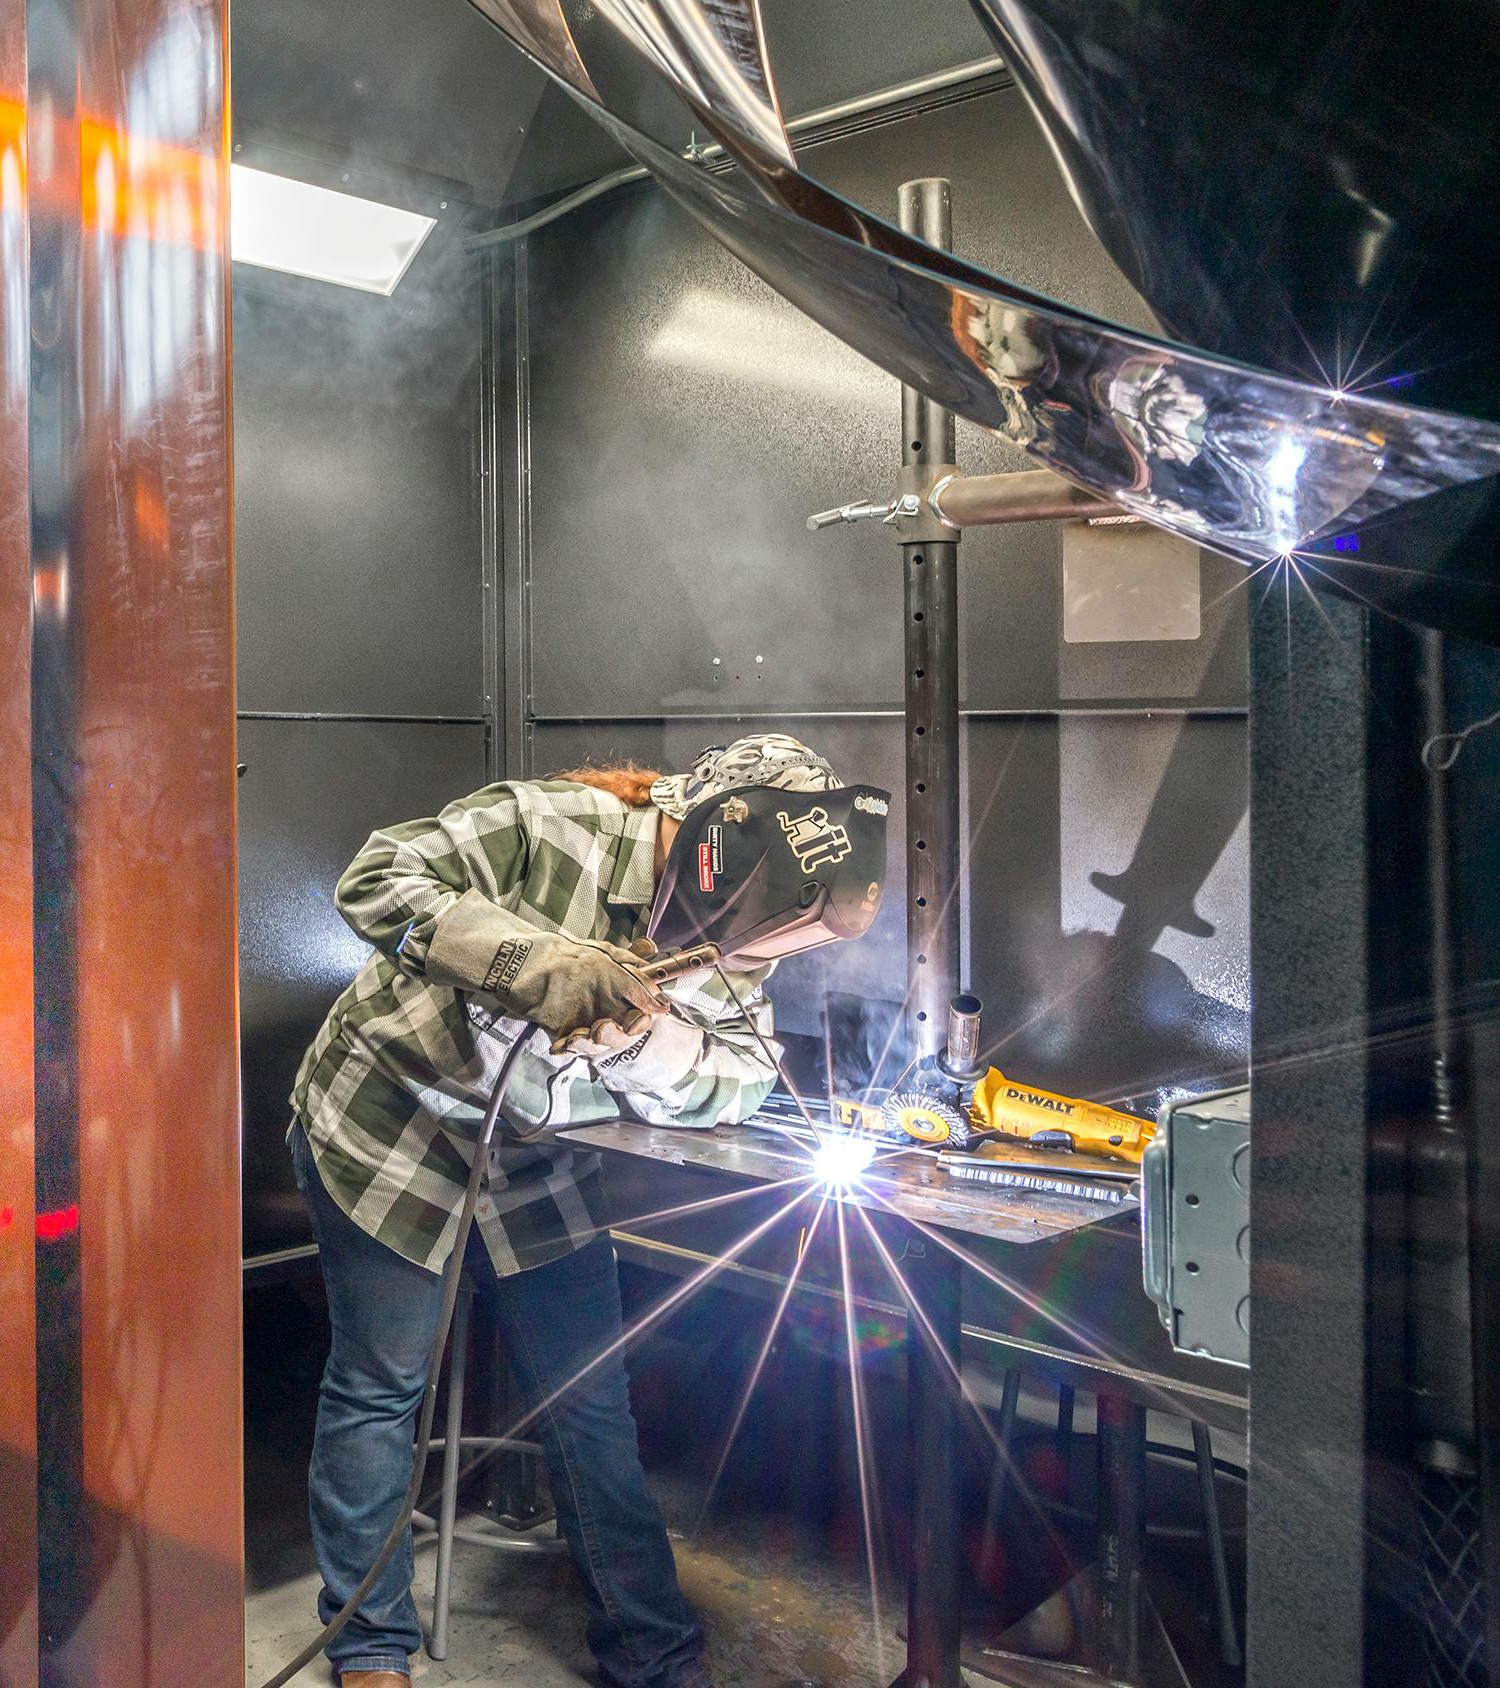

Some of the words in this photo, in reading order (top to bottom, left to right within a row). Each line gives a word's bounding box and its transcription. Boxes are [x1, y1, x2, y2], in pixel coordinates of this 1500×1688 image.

[702, 865, 710, 889] BROKE
[484, 942, 516, 990] INCOLN
[499, 943, 529, 991] ELECTRIC
